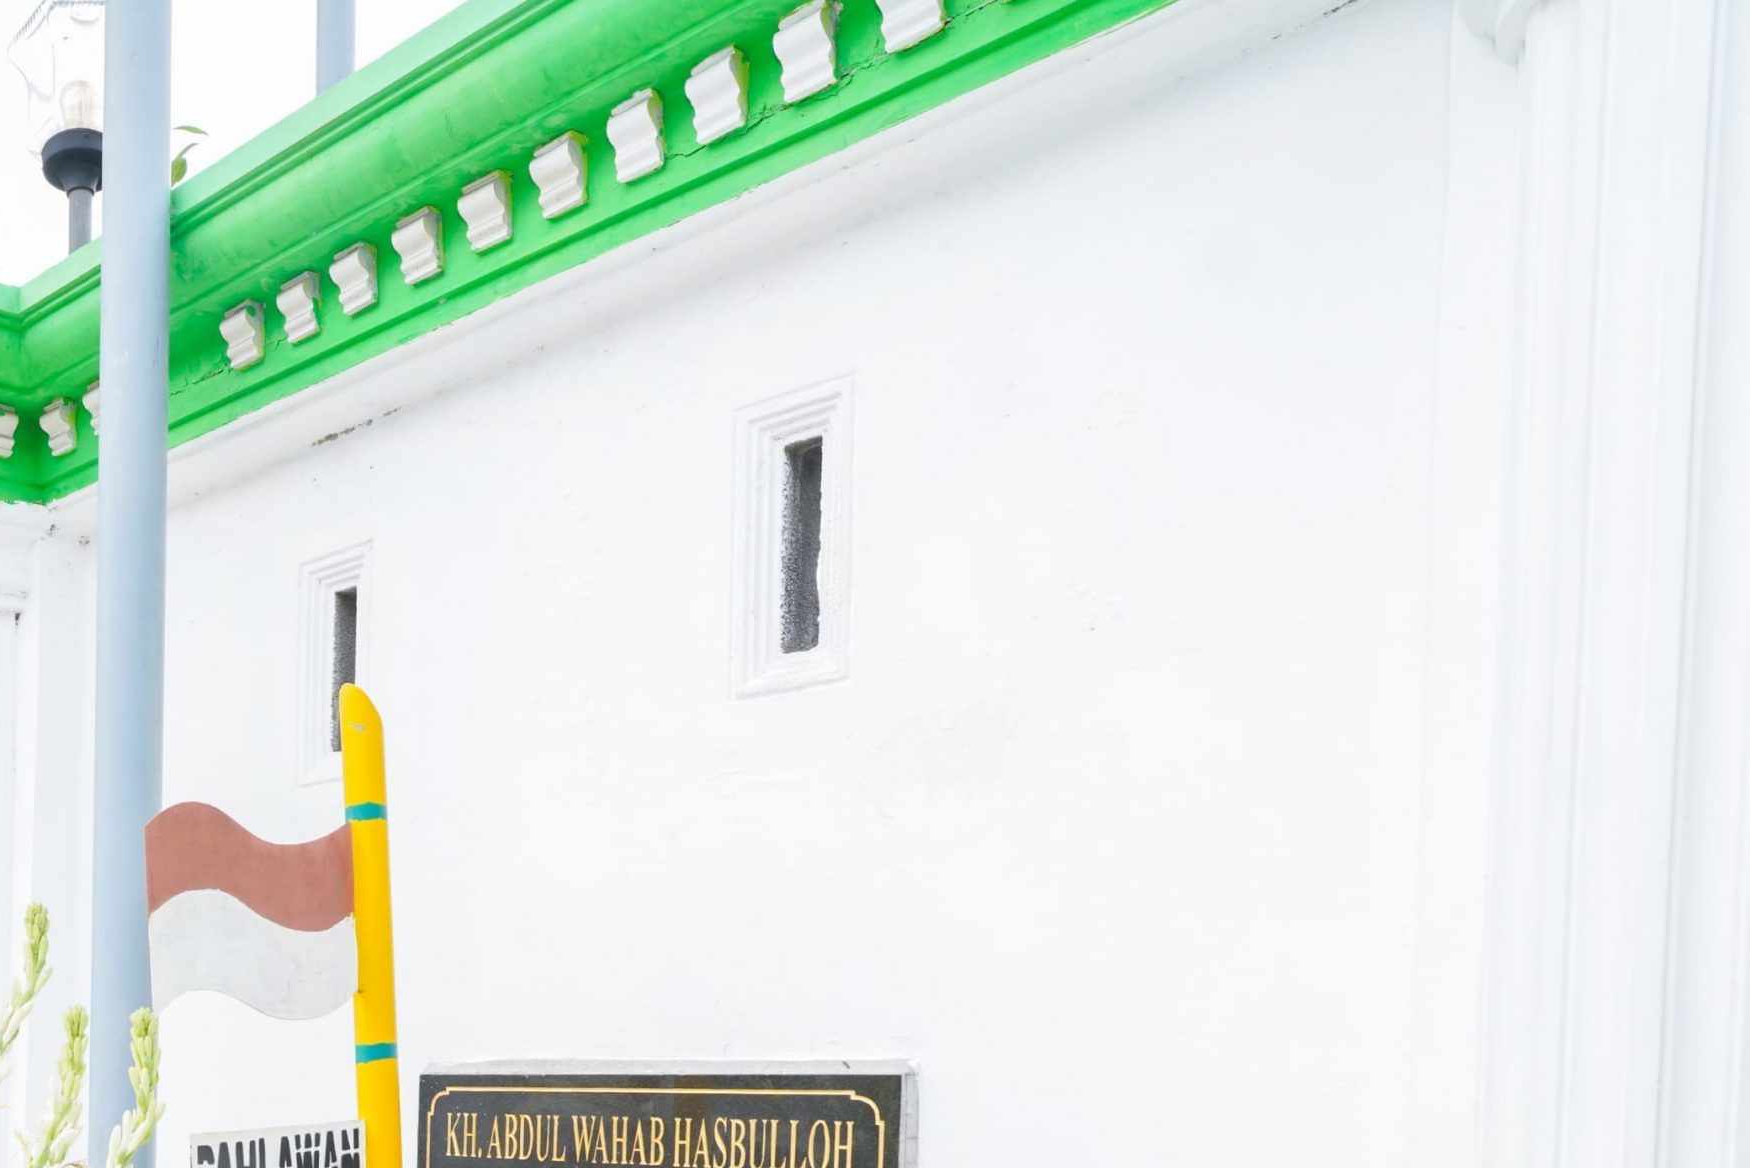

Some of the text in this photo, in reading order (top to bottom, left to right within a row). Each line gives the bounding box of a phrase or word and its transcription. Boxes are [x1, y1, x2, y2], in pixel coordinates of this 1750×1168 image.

[445, 1112, 483, 1158] KH.
[486, 1114, 566, 1163] ABDUL
[571, 1115, 664, 1167] WAHAB
